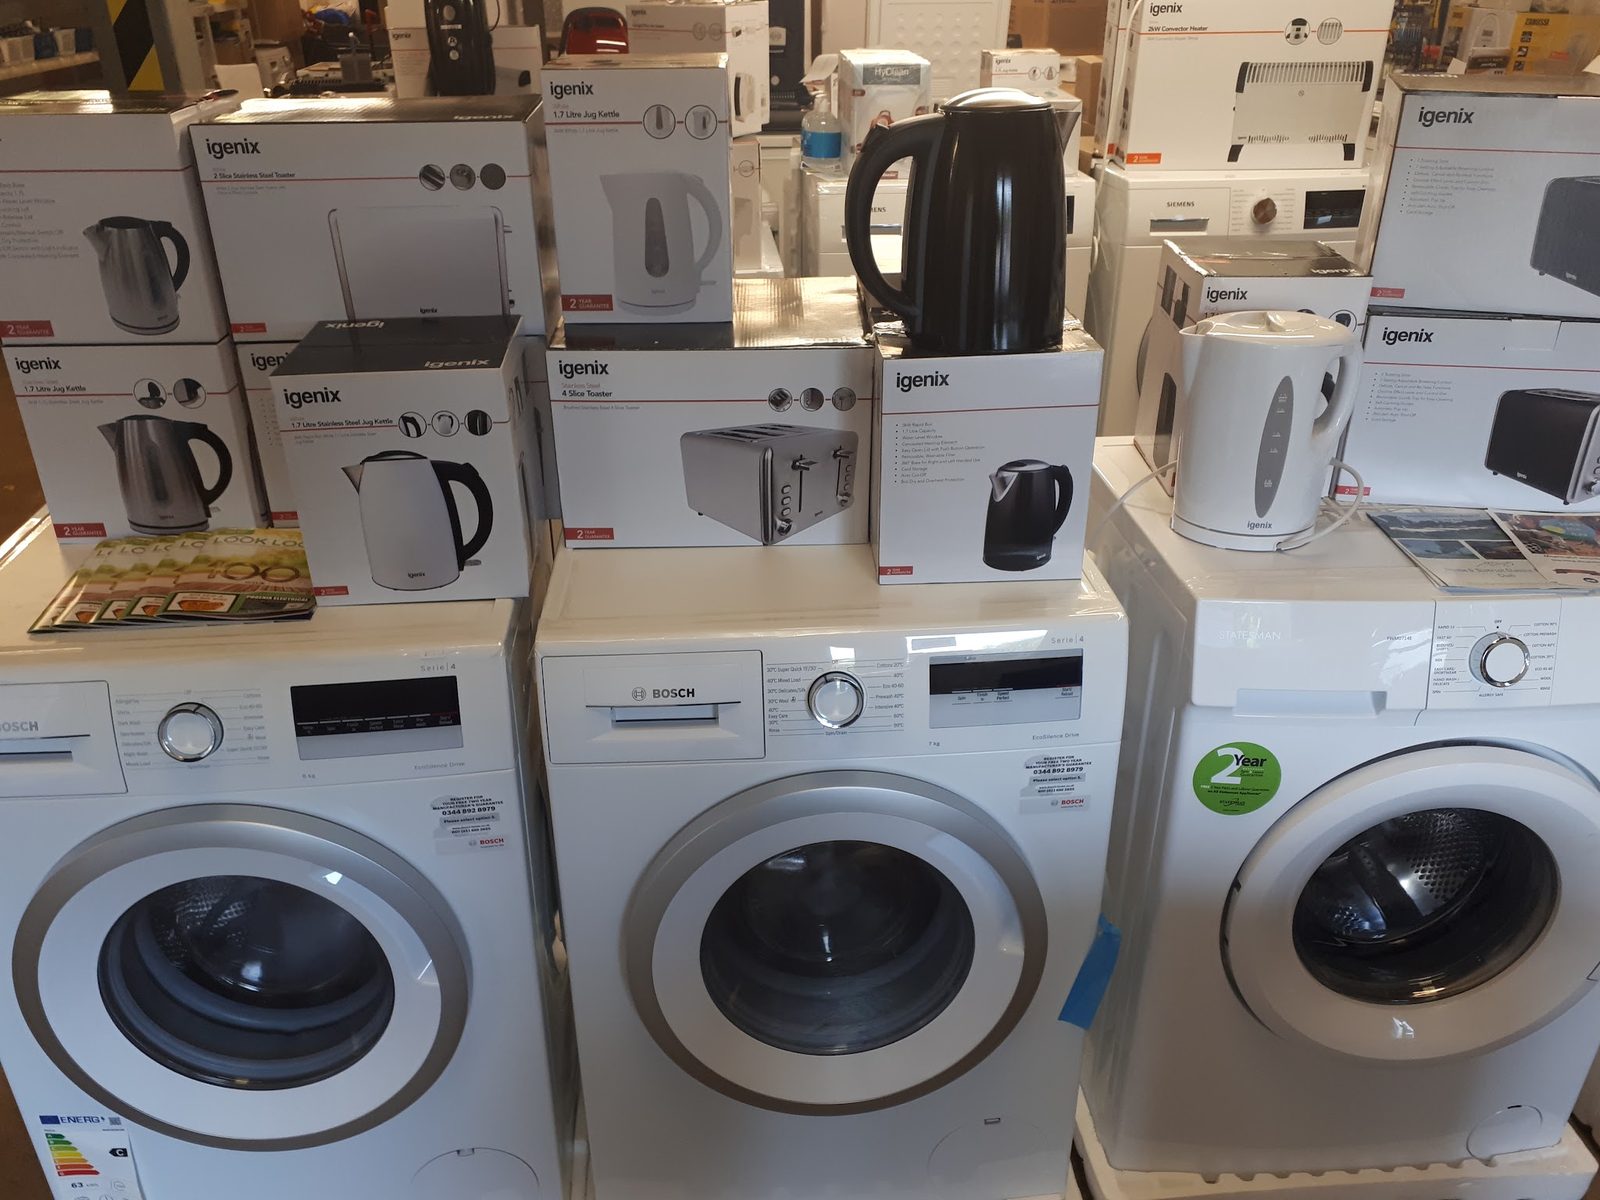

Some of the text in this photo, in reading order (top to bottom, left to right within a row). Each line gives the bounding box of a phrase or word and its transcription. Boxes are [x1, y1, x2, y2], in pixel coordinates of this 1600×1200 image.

[1150, 2, 1183, 17] igenix
[550, 81, 594, 99] igenix
[583, 111, 597, 120] Jug
[598, 110, 620, 118] Kettle
[1418, 107, 1475, 127] igenix
[206, 138, 261, 160] igenix
[1206, 286, 1248, 303] igenix
[570, 298, 577, 309] 2
[7, 324, 16, 335] 2
[1382, 327, 1434, 345] igenix
[15, 357, 62, 374] igenix
[424, 359, 490, 368] igenix
[558, 360, 609, 379] igenix
[896, 371, 950, 393] igenix
[52, 385, 65, 393] Jug
[284, 387, 341, 409] igenix
[317, 420, 345, 428] Stainless
[362, 419, 374, 427] Jug
[1247, 520, 1272, 530] igenix
[64, 527, 71, 536] 2
[577, 530, 583, 539] 2
[214, 536, 268, 545] LOOK
[1218, 631, 1281, 640] STATESMAN
[419, 665, 445, 673] Serie
[652, 688, 695, 698] BOSCH
[1210, 747, 1244, 784] 2
[1234, 754, 1267, 767] Year
